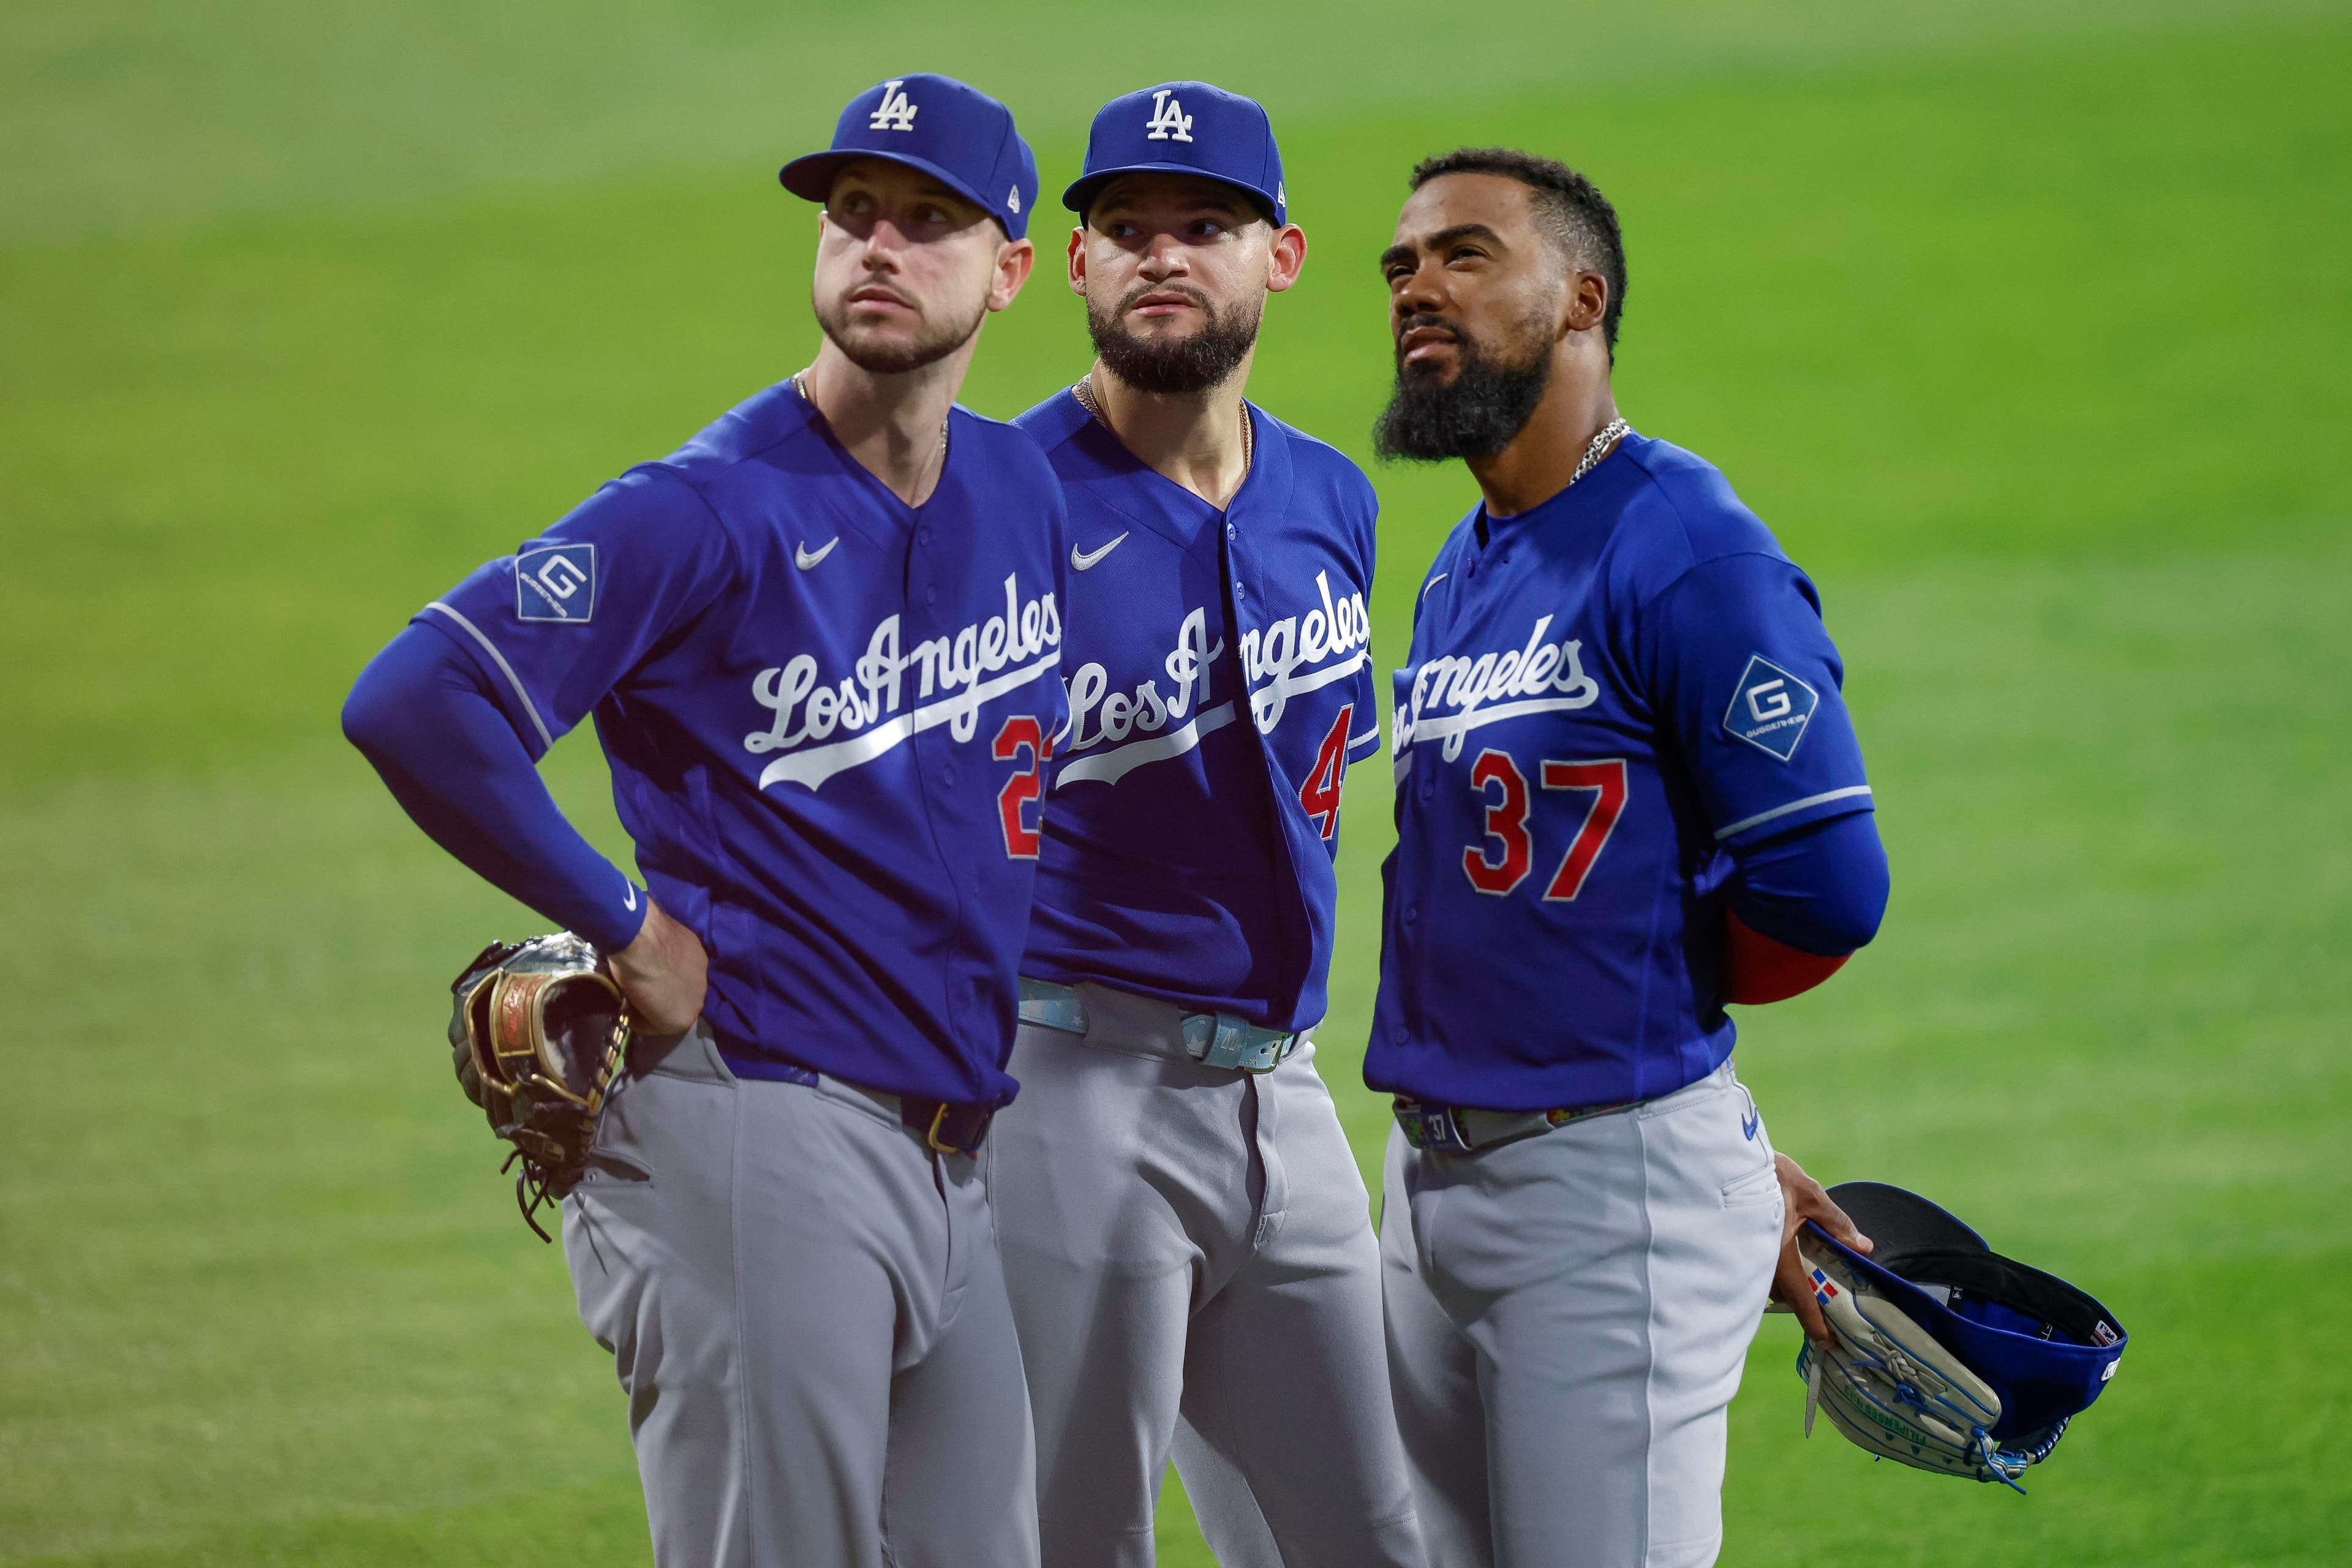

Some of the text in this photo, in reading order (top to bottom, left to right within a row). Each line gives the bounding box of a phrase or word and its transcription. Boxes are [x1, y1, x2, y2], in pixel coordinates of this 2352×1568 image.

[869, 80, 918, 131] LA
[1146, 89, 1193, 143] LA
[538, 554, 587, 600] G
[744, 571, 1061, 753] Los Angeles
[1746, 679, 1791, 722] G
[1462, 747, 1629, 902] 37
[1428, 1114, 1446, 1140] 37
